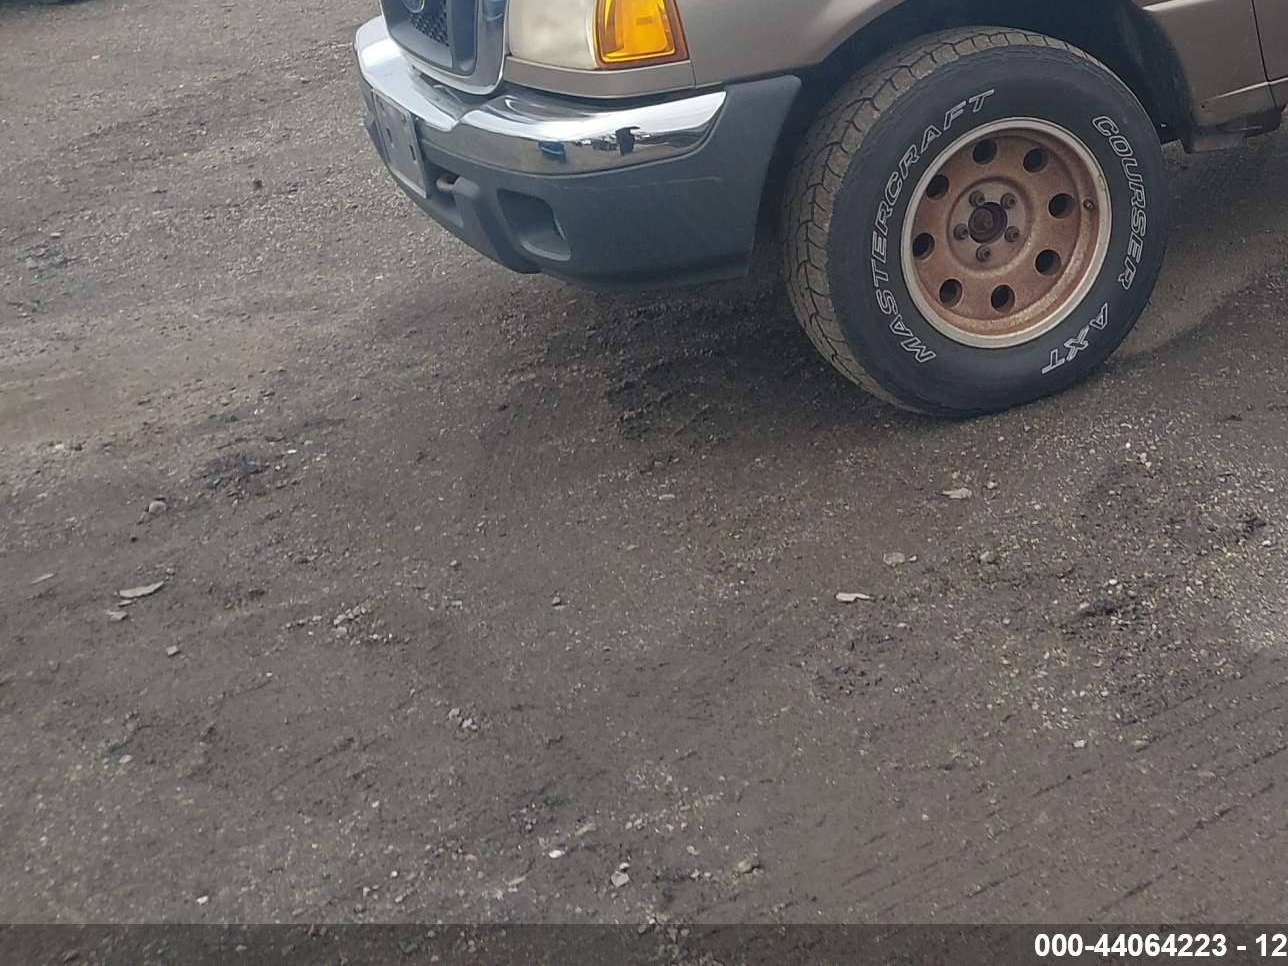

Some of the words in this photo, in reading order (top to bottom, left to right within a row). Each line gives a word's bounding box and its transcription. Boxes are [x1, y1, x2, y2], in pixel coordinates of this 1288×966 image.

[870, 89, 995, 364] MASTERCRAFT
[1091, 115, 1147, 290] COURSER
[1041, 302, 1109, 374] AXT
